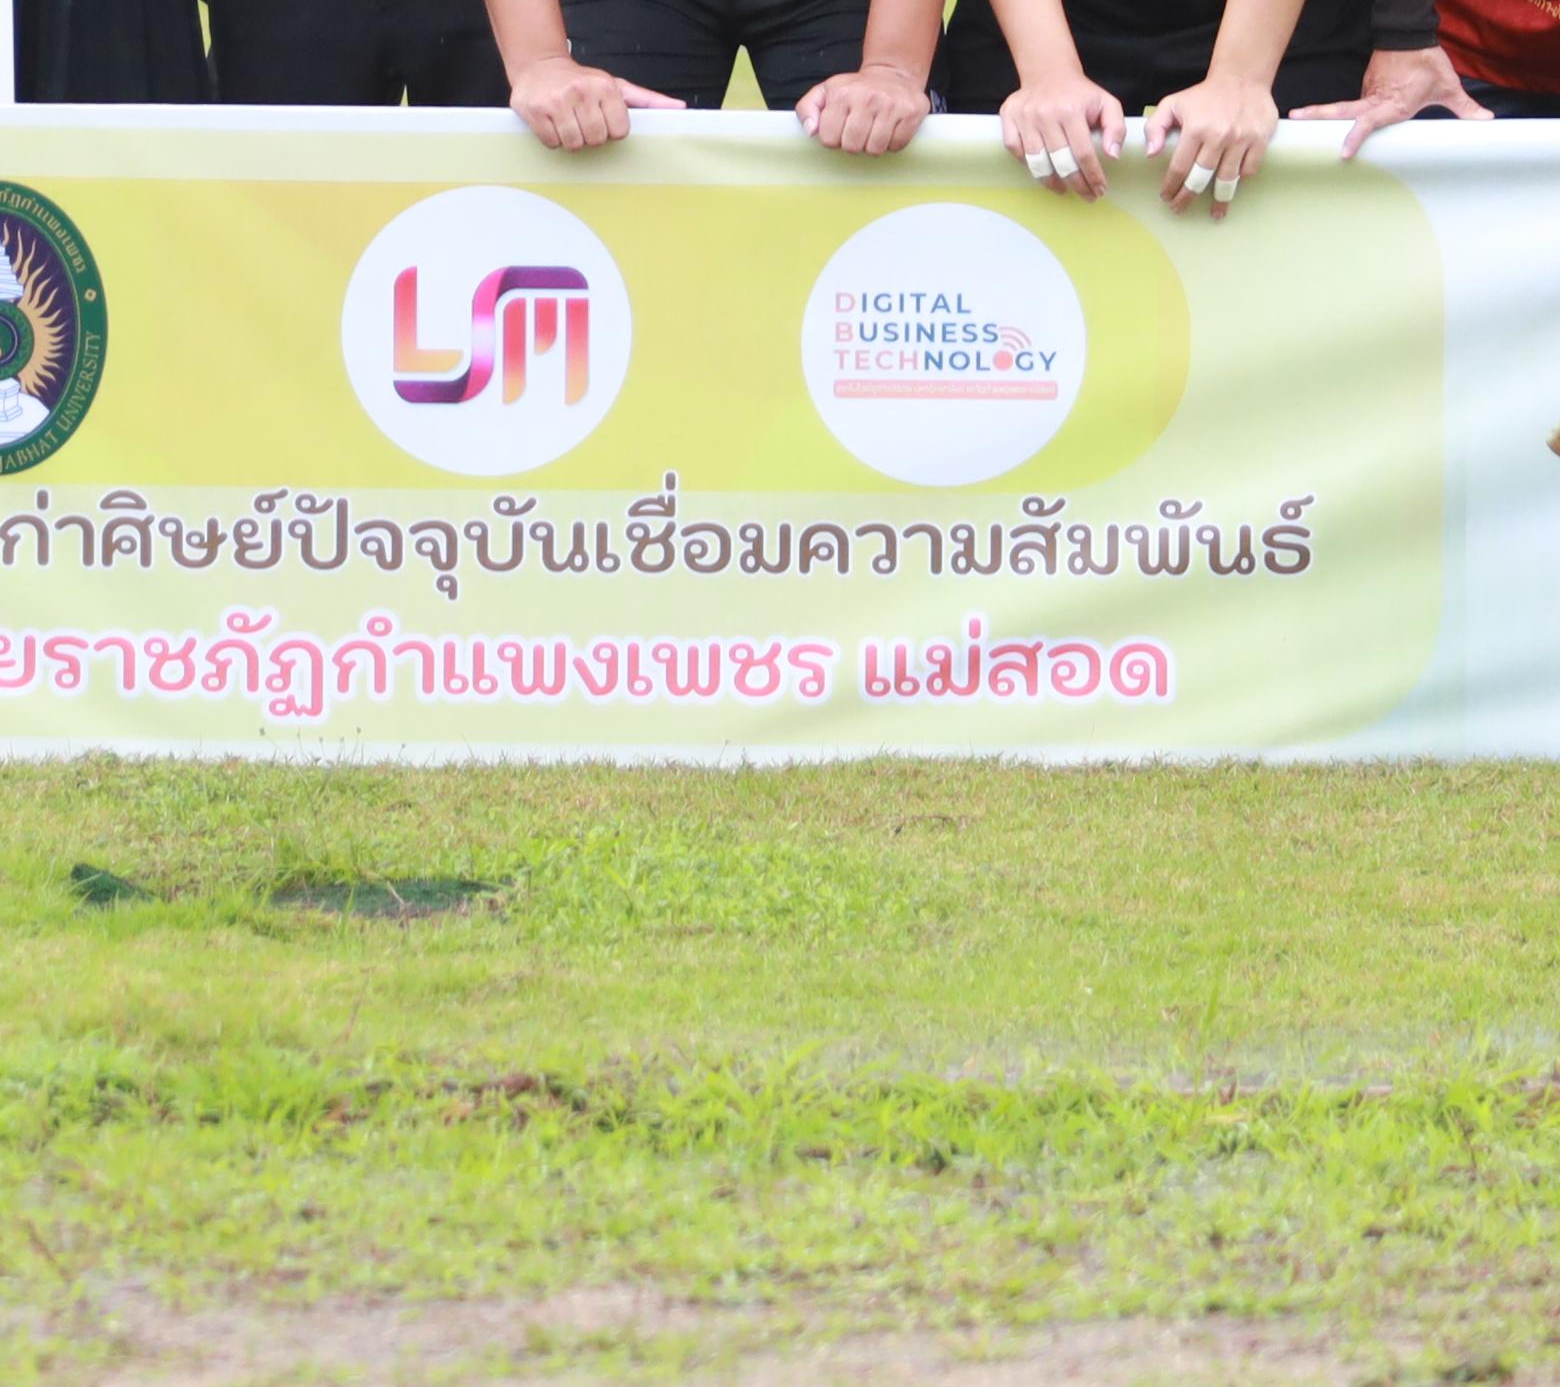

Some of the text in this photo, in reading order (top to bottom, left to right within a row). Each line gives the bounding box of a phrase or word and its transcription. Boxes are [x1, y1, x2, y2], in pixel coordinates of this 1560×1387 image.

[834, 292, 972, 314] DIGITAL
[835, 321, 1000, 343] BUSINESS
[55, 330, 101, 431] UNIVERSITY
[864, 617, 1170, 699] แม่สอด
